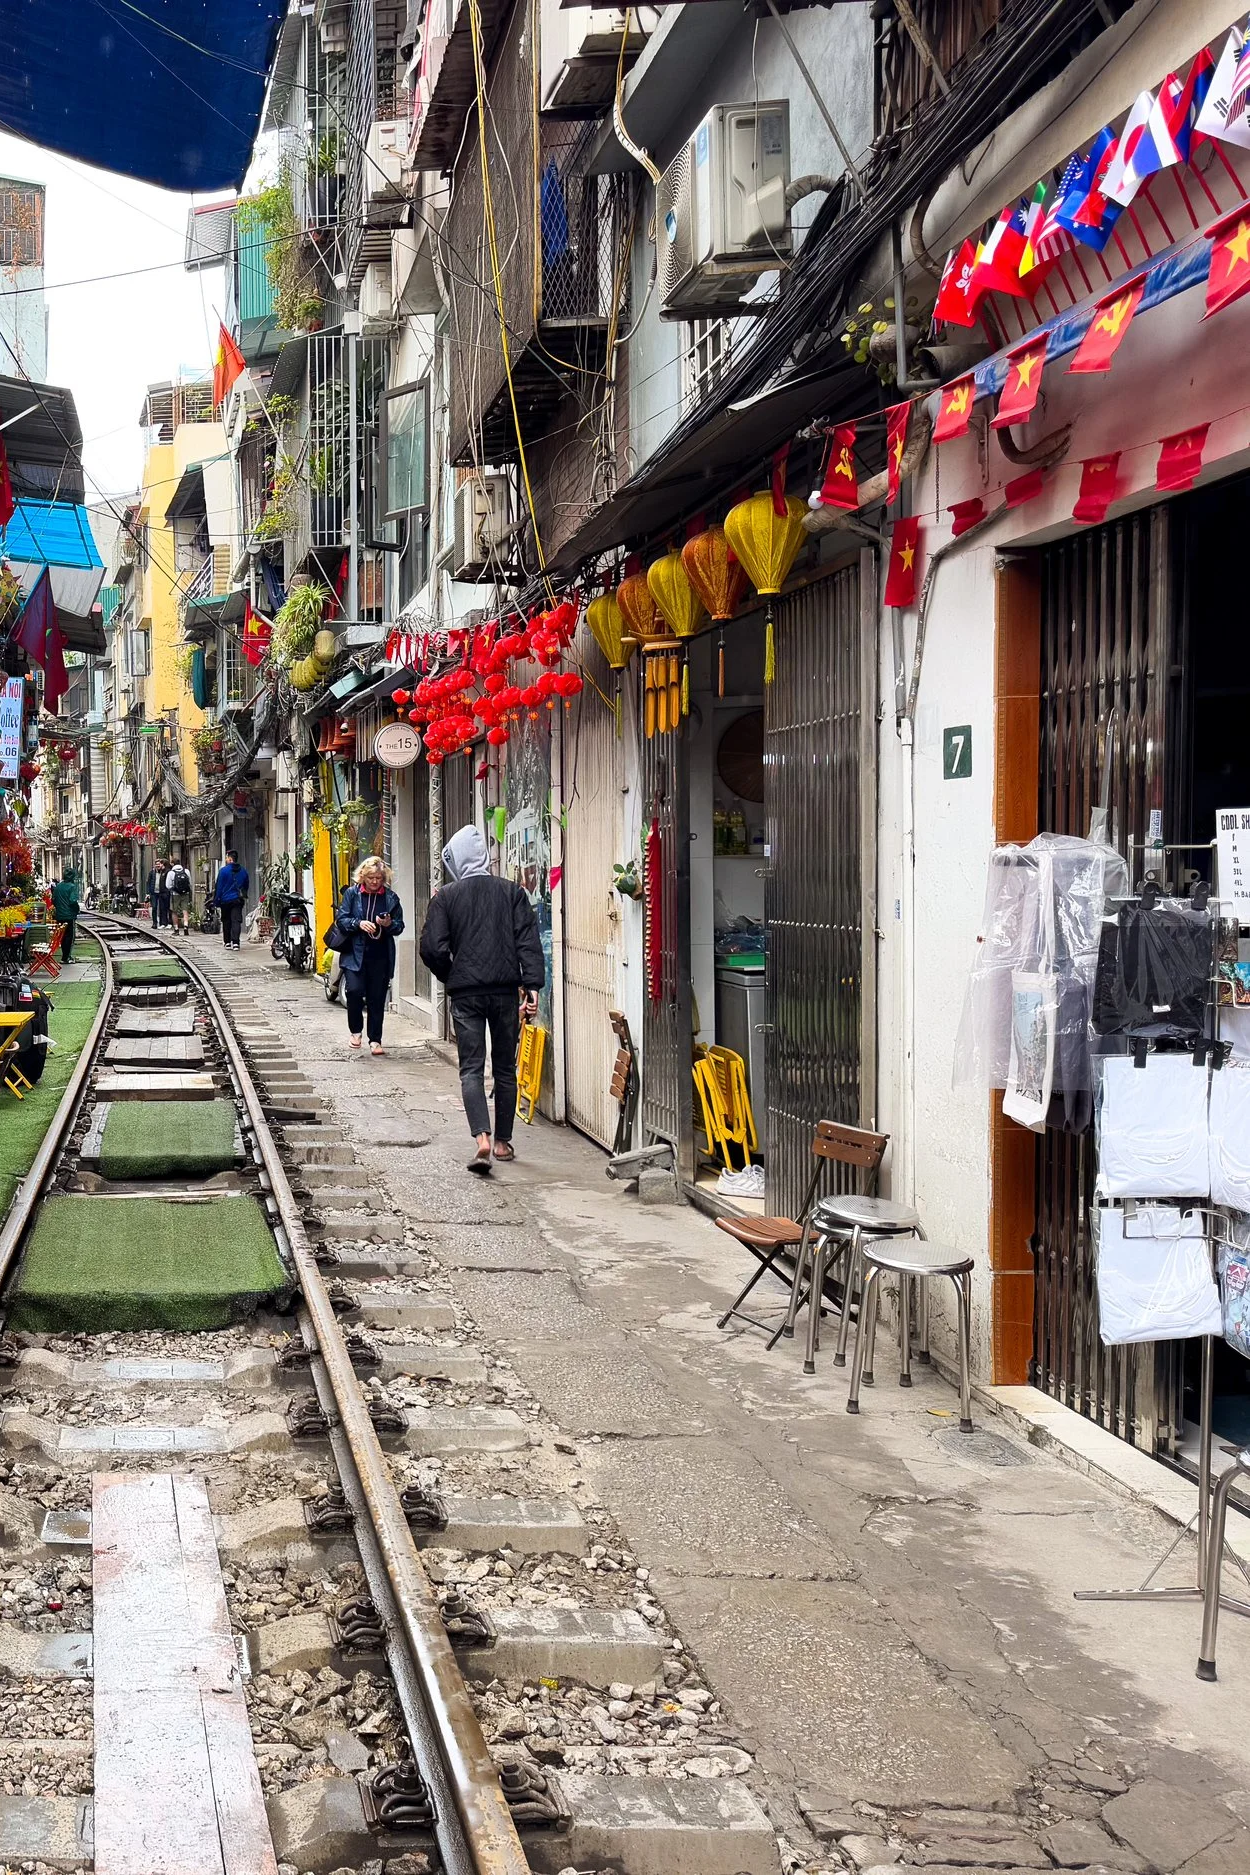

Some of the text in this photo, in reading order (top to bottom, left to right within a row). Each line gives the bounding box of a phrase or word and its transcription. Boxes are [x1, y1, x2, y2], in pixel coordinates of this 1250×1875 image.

[398, 738, 412, 750] 15
[951, 735, 965, 774] 7
[1220, 814, 1240, 831] COOL
